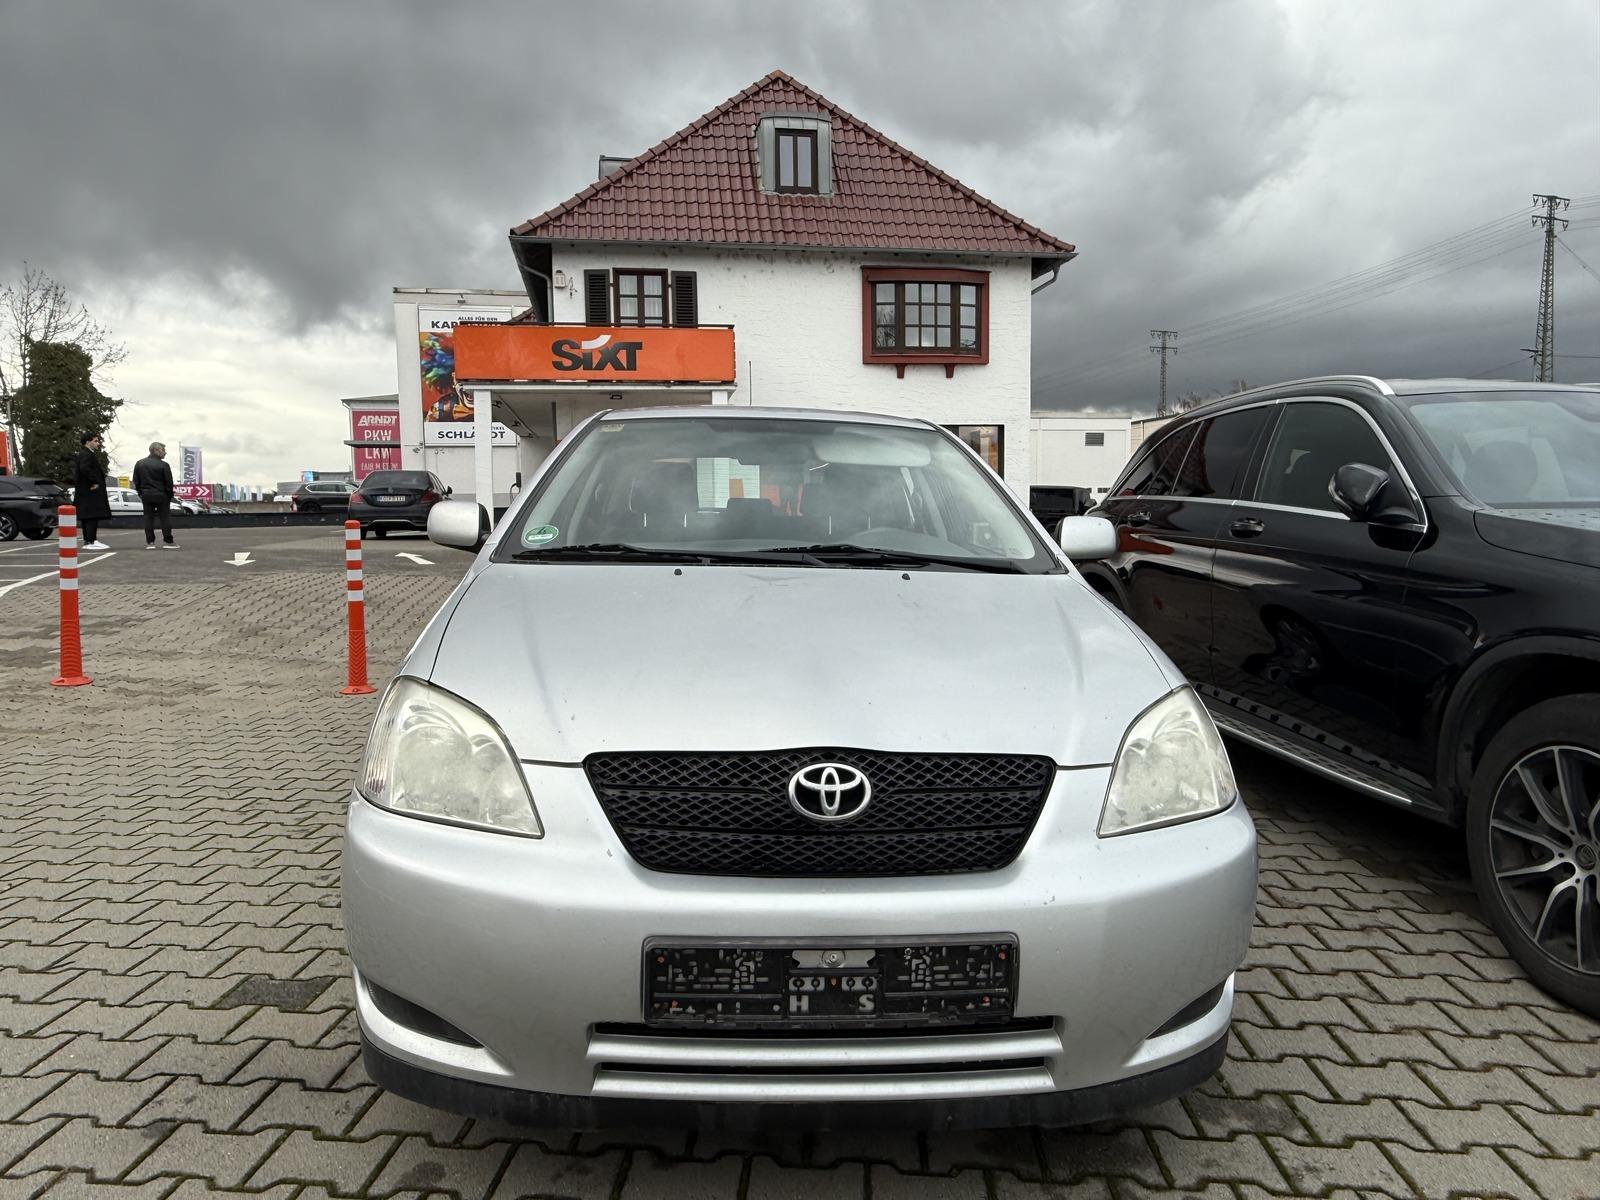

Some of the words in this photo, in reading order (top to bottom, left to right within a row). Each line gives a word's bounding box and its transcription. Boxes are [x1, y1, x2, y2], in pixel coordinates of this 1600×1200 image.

[551, 335, 643, 371] SIXT
[358, 415, 397, 426] ARNDT
[364, 430, 392, 441] PKW
